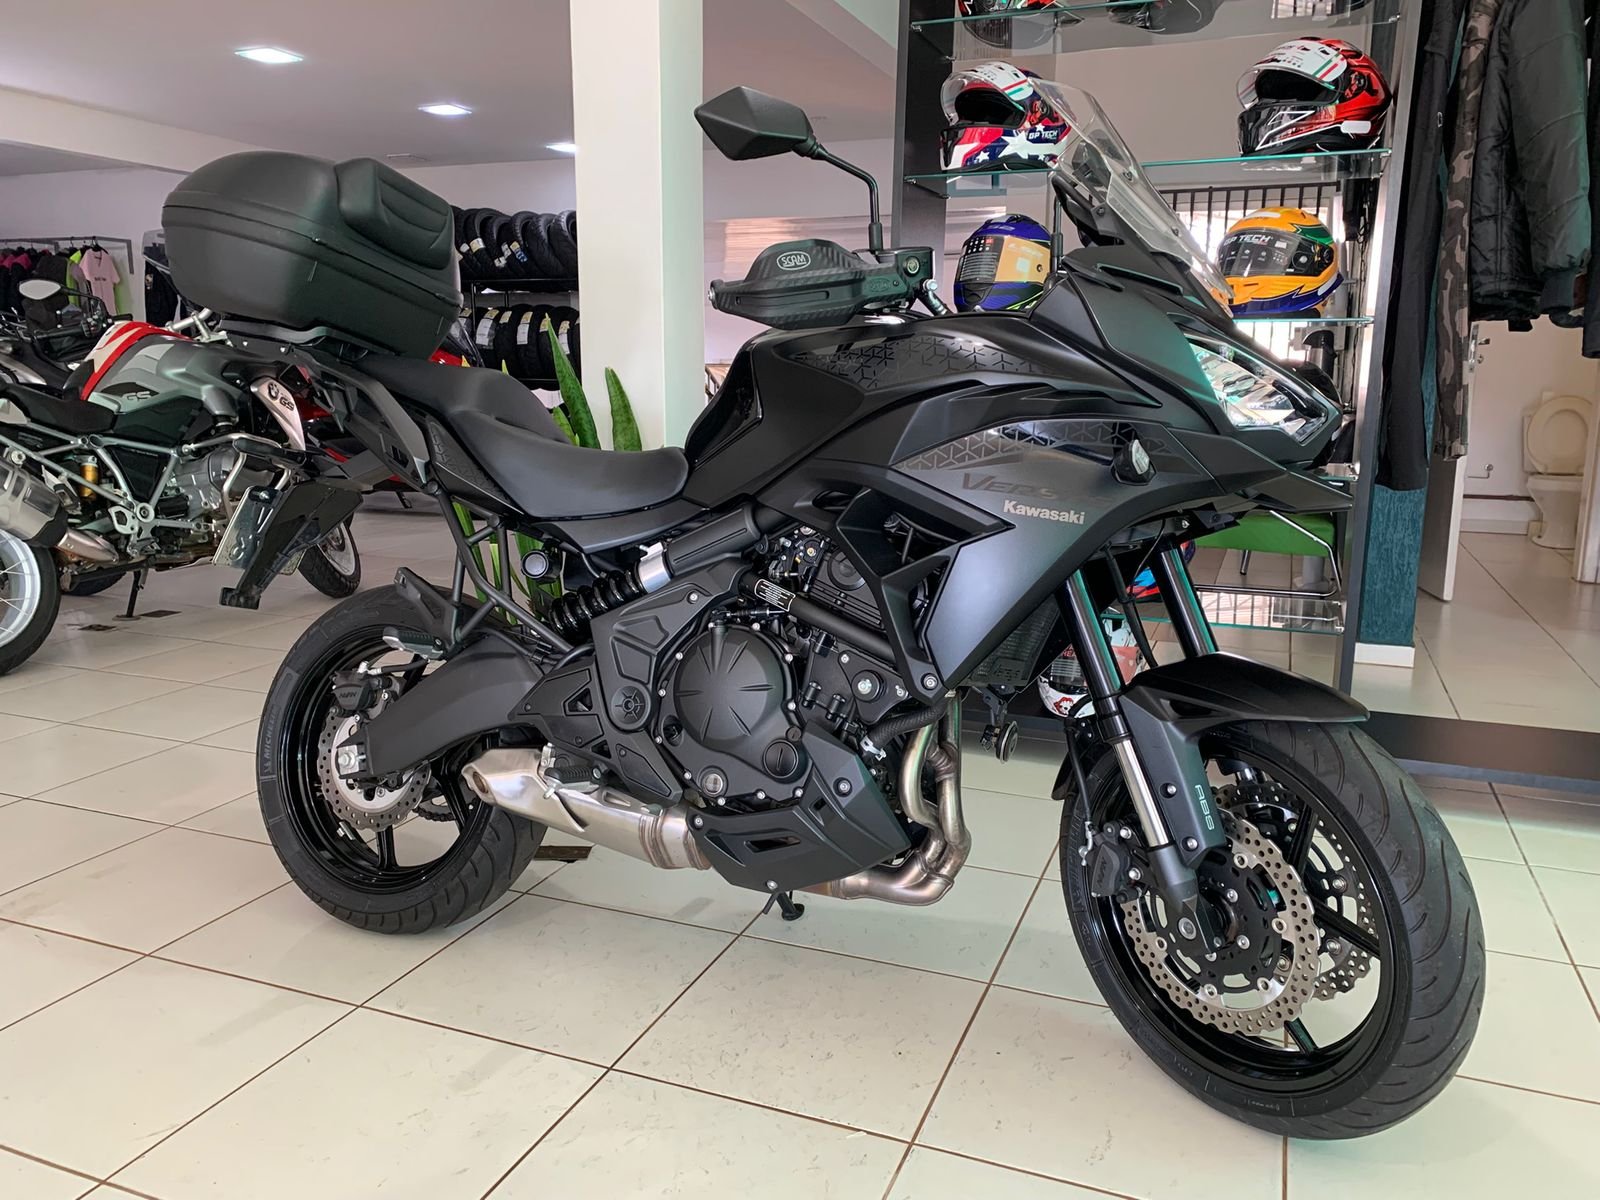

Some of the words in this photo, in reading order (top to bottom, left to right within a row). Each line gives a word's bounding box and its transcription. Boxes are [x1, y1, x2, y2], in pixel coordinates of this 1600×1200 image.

[1238, 233, 1271, 244] TECH
[781, 254, 807, 267] SCAM
[1003, 500, 1086, 525] Kawasaki
[1194, 784, 1215, 831] ABS
